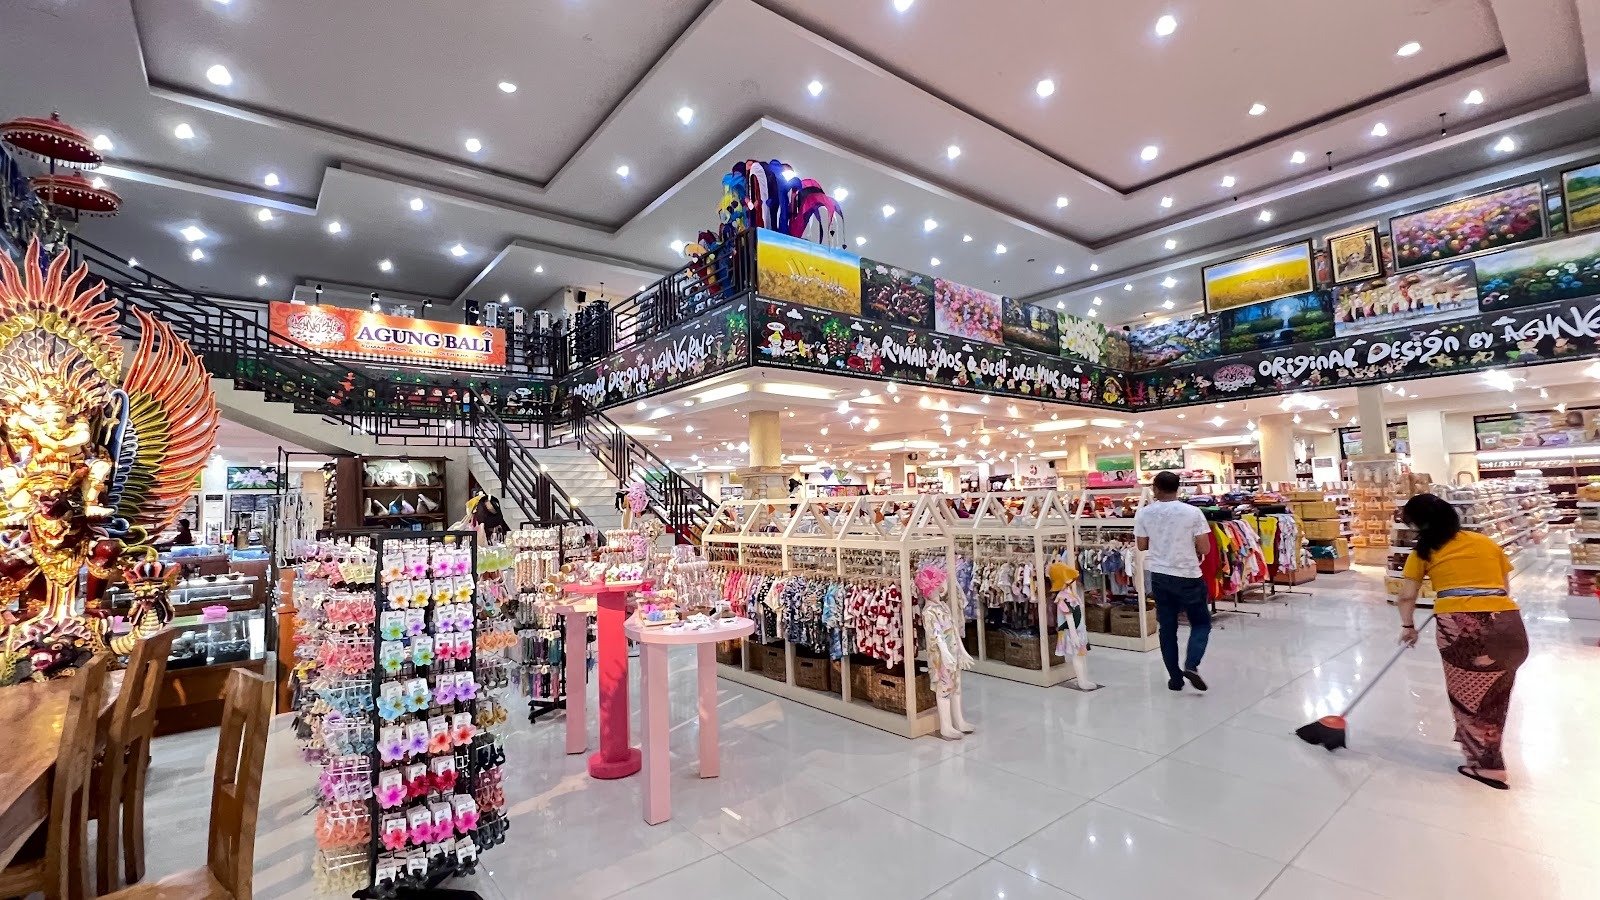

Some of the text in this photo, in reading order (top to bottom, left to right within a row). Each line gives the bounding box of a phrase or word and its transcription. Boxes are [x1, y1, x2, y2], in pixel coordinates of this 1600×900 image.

[357, 326, 492, 352] AGUNG BALI
[1468, 332, 1494, 349] BY
[881, 335, 928, 368] RUMAH
[967, 355, 977, 373] &
